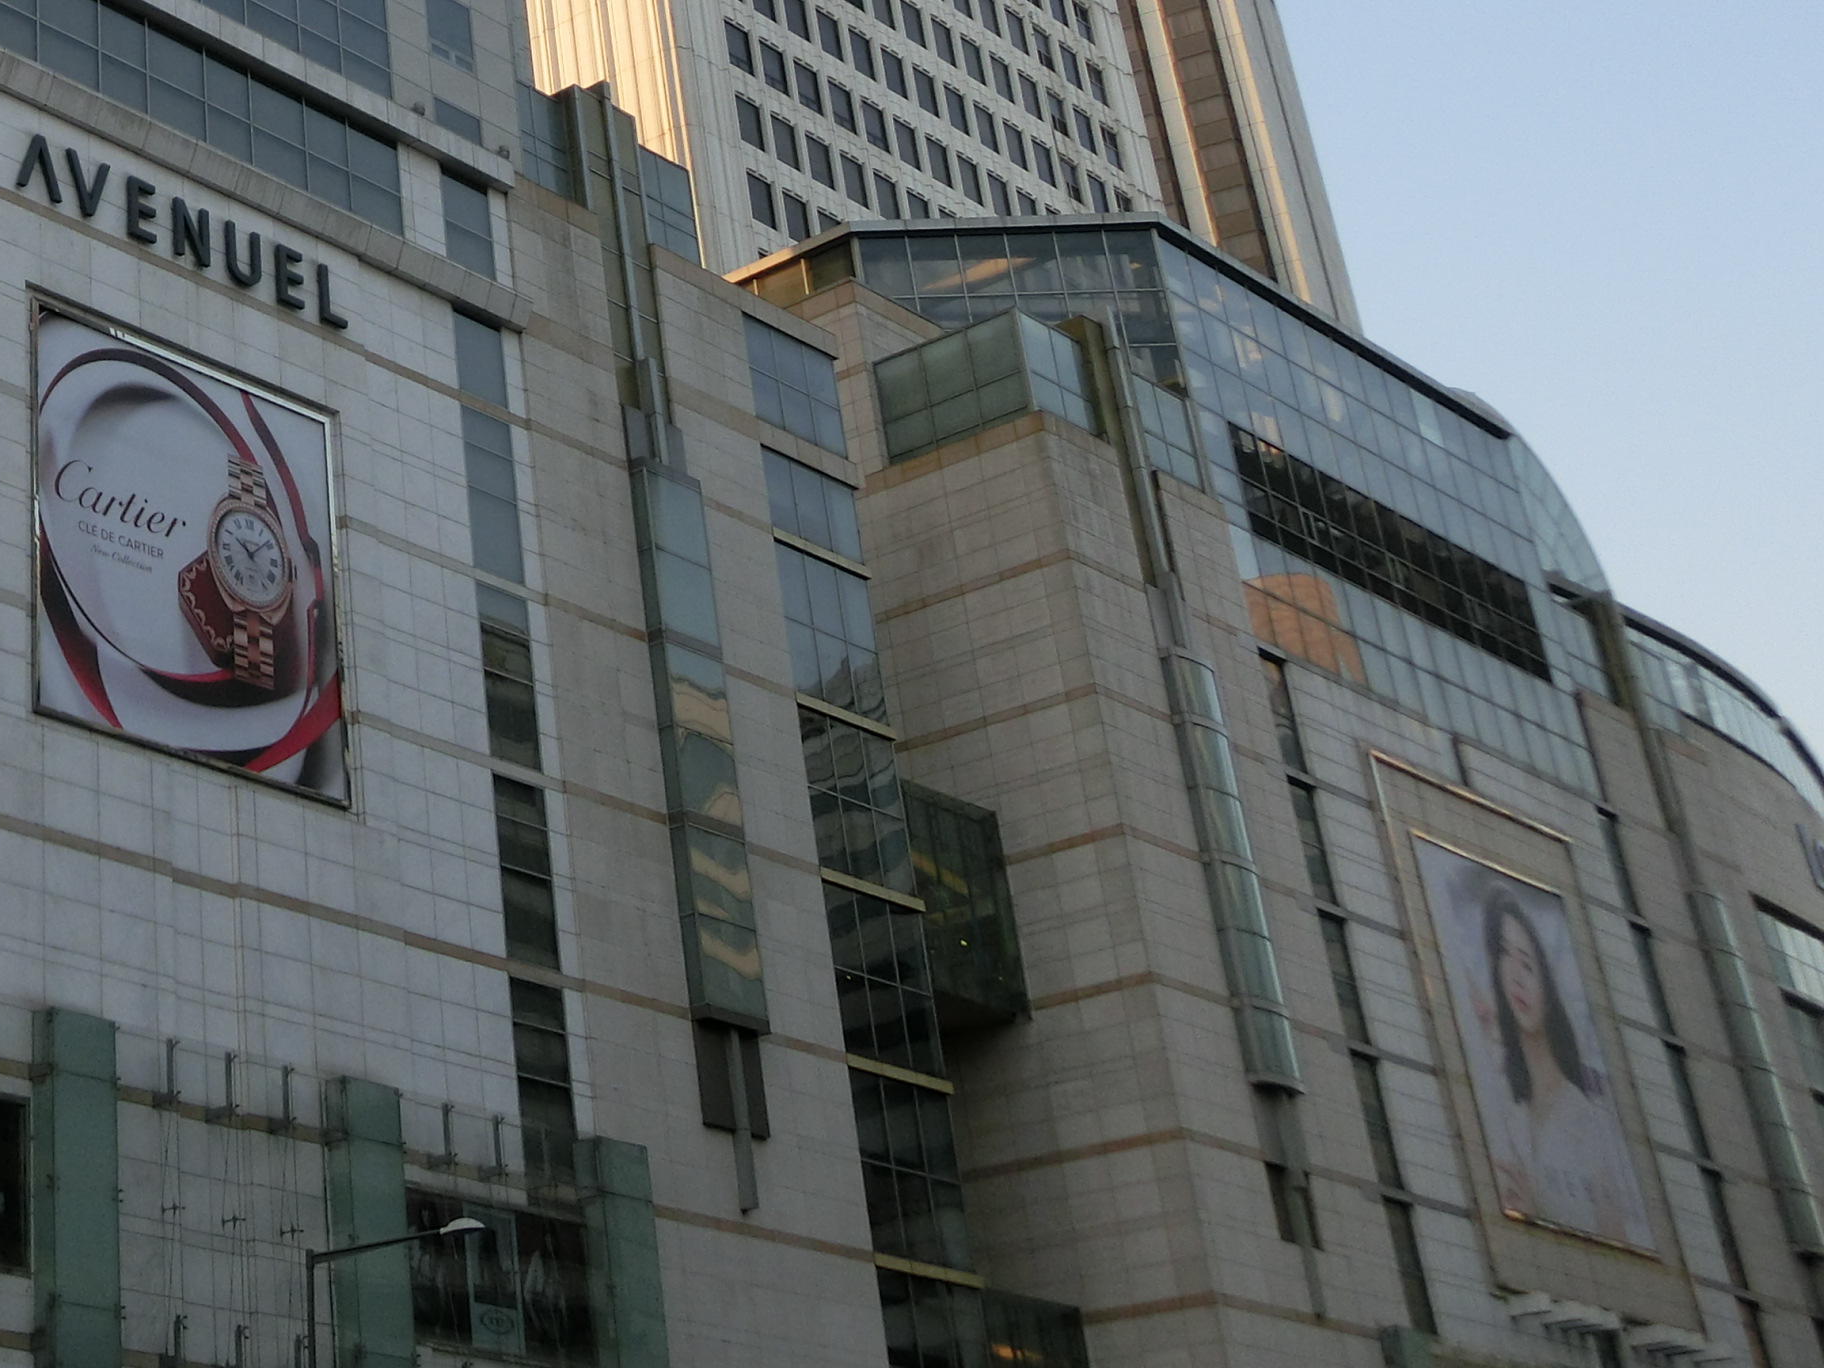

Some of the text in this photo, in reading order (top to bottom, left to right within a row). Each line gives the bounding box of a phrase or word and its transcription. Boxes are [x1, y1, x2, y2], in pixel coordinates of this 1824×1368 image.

[16, 133, 349, 330] AVENUEL
[54, 460, 187, 538] Cartier
[101, 529, 115, 543] DE
[118, 535, 164, 559] CARTIER
